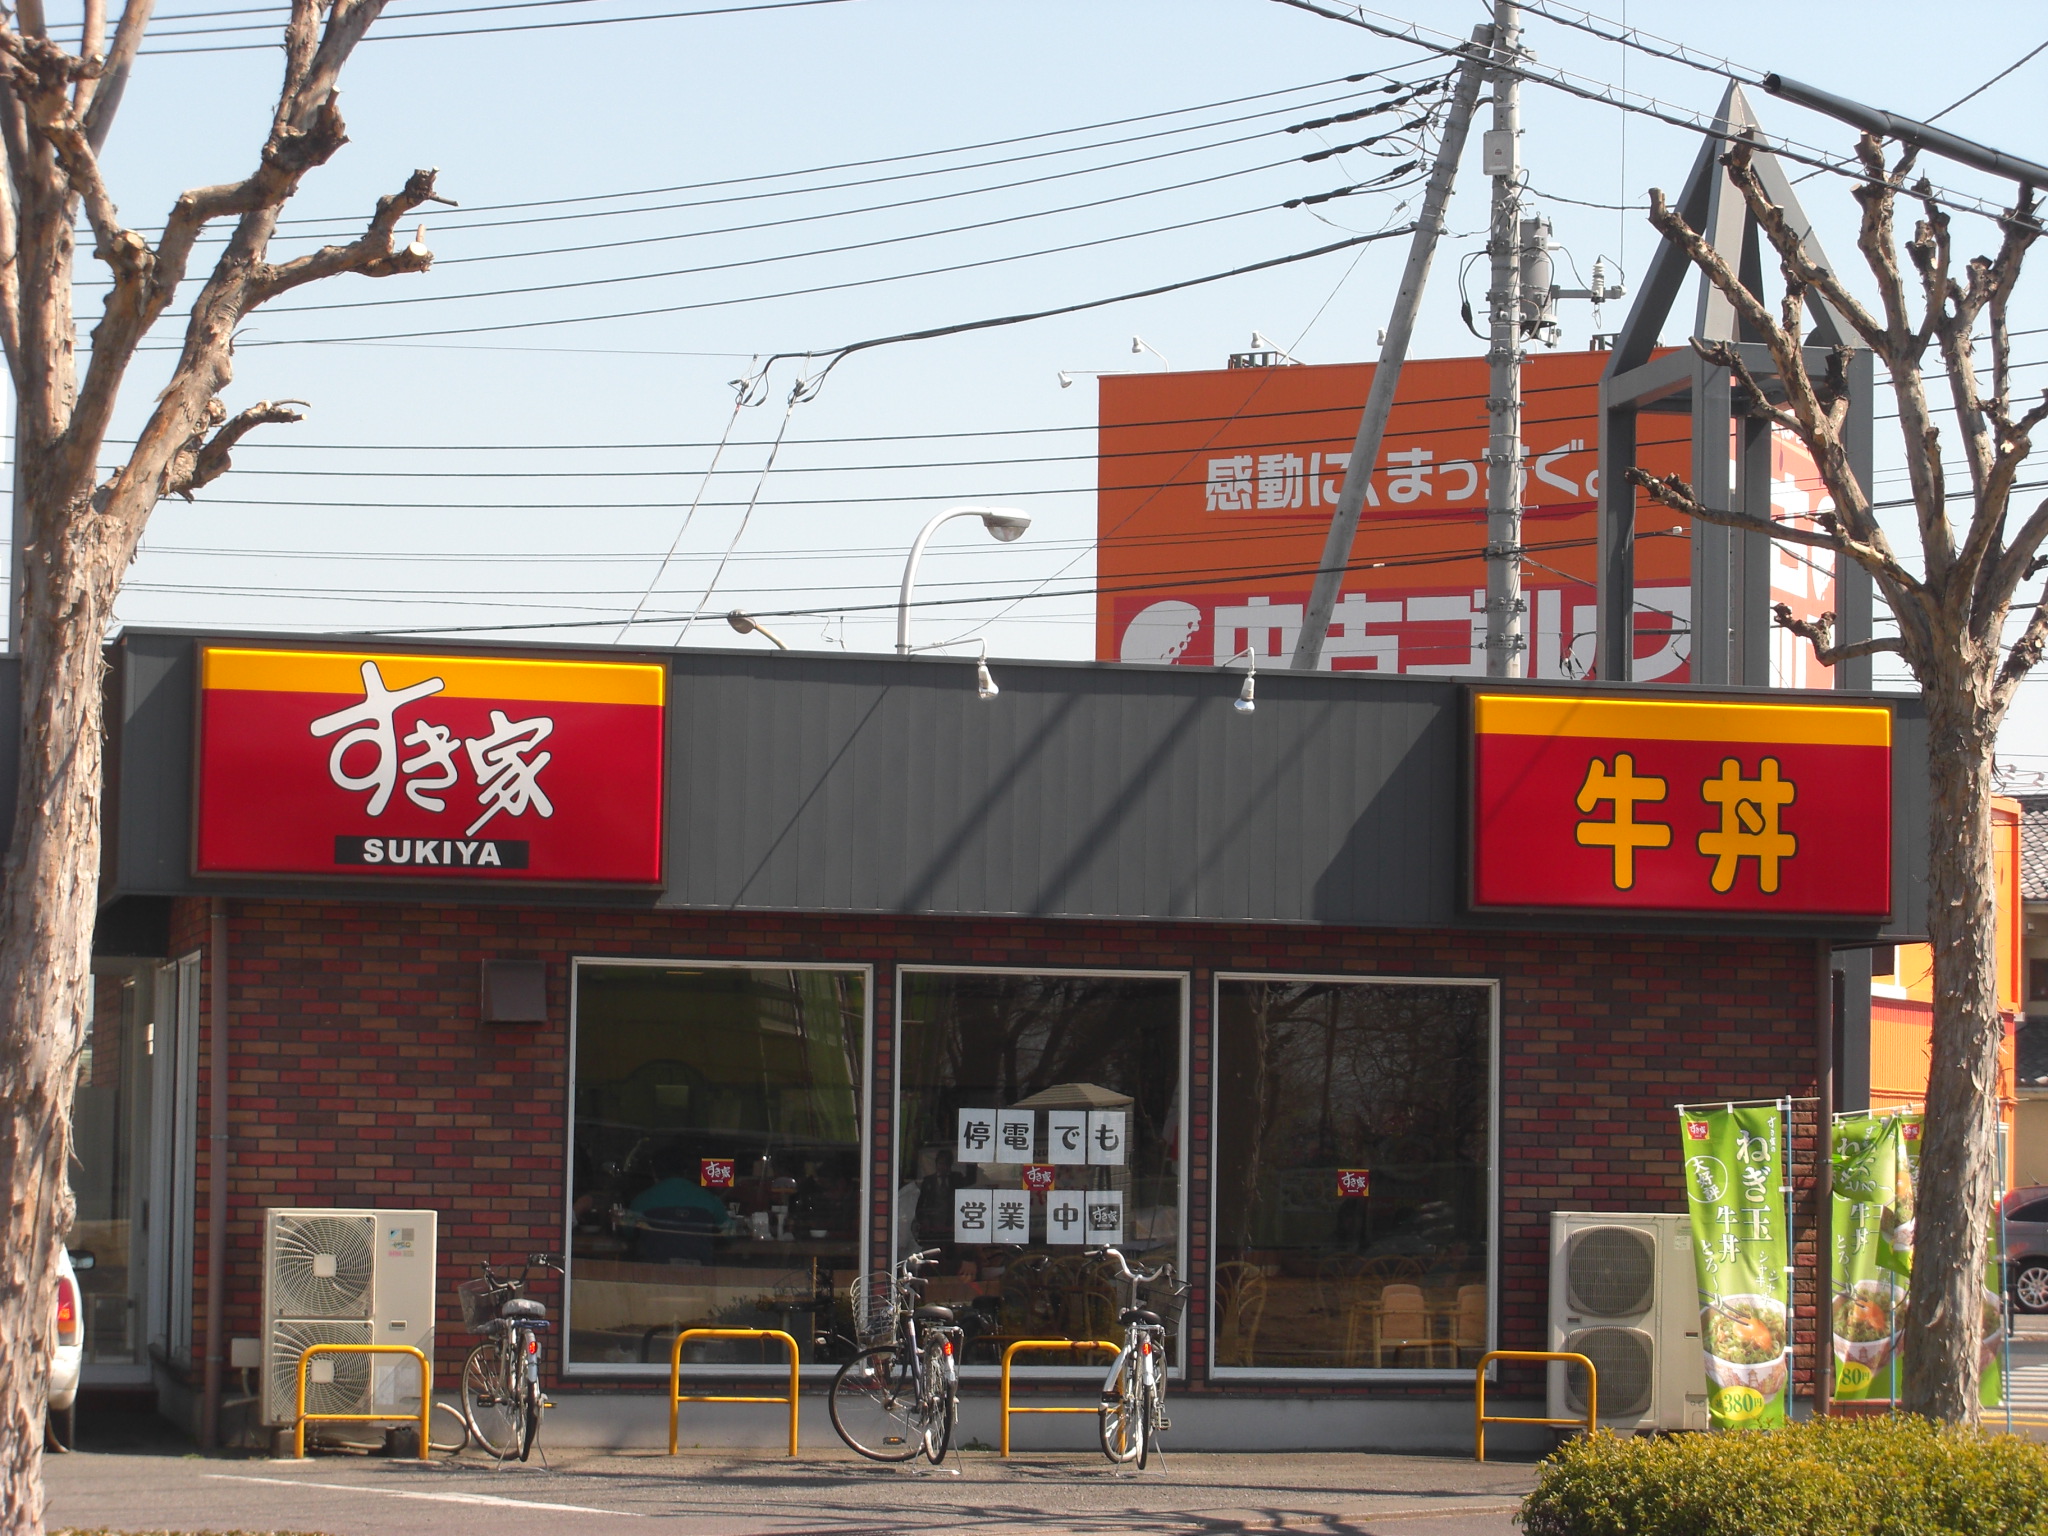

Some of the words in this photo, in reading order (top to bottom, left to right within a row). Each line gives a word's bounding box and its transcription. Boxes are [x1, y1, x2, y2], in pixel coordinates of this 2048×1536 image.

[310, 660, 554, 837] すき家
[363, 838, 502, 866] SUKIYA
[1574, 751, 1799, 895] 牛丼
[1736, 1129, 1774, 1242] ねぎ玉
[959, 1201, 1079, 1231] 営業中
[1716, 1205, 1742, 1264] 牛丼
[1850, 1202, 1870, 1255] 牛丼
